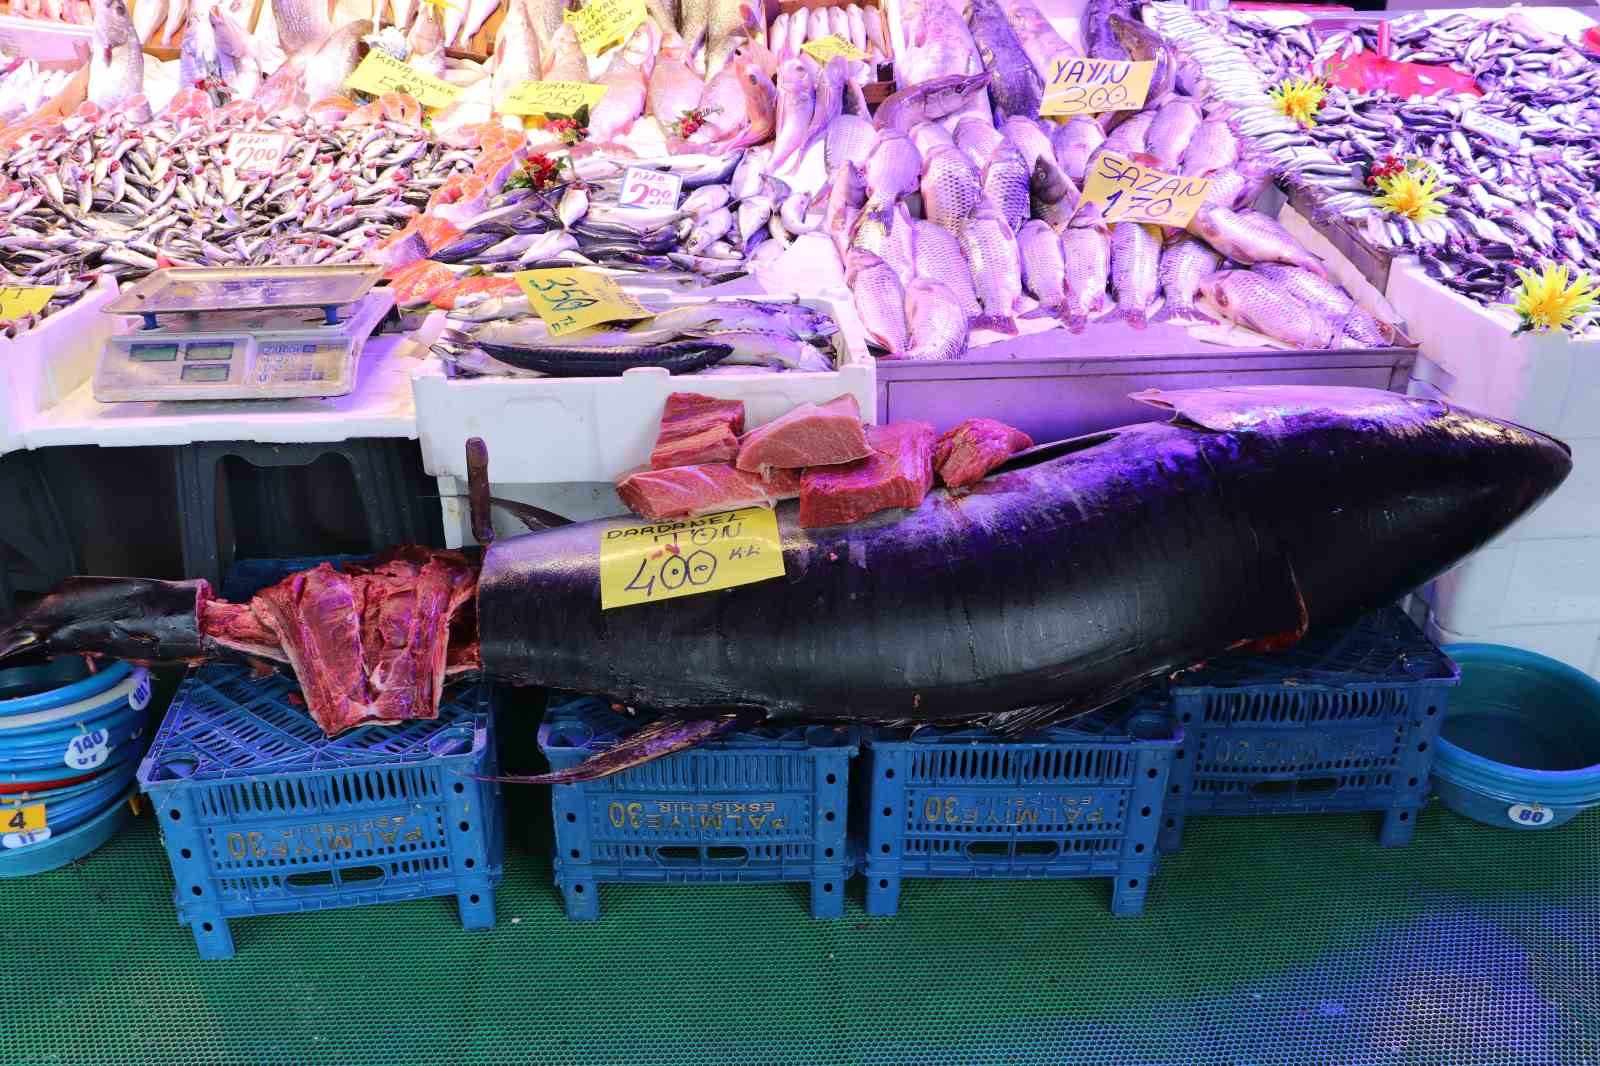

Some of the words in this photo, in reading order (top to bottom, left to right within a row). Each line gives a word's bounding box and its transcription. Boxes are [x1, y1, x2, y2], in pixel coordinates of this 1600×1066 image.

[1052, 59, 1131, 85] YAYIN
[1054, 84, 1128, 113] 300
[1098, 156, 1208, 198] SAZAN
[1101, 189, 1173, 218] 170
[528, 276, 600, 312] 350
[607, 513, 750, 541] DARDANEL
[654, 522, 742, 549] TON
[623, 549, 718, 597] 400
[72, 730, 104, 754] 140
[8, 810, 27, 830] 4
[608, 801, 643, 829] 30
